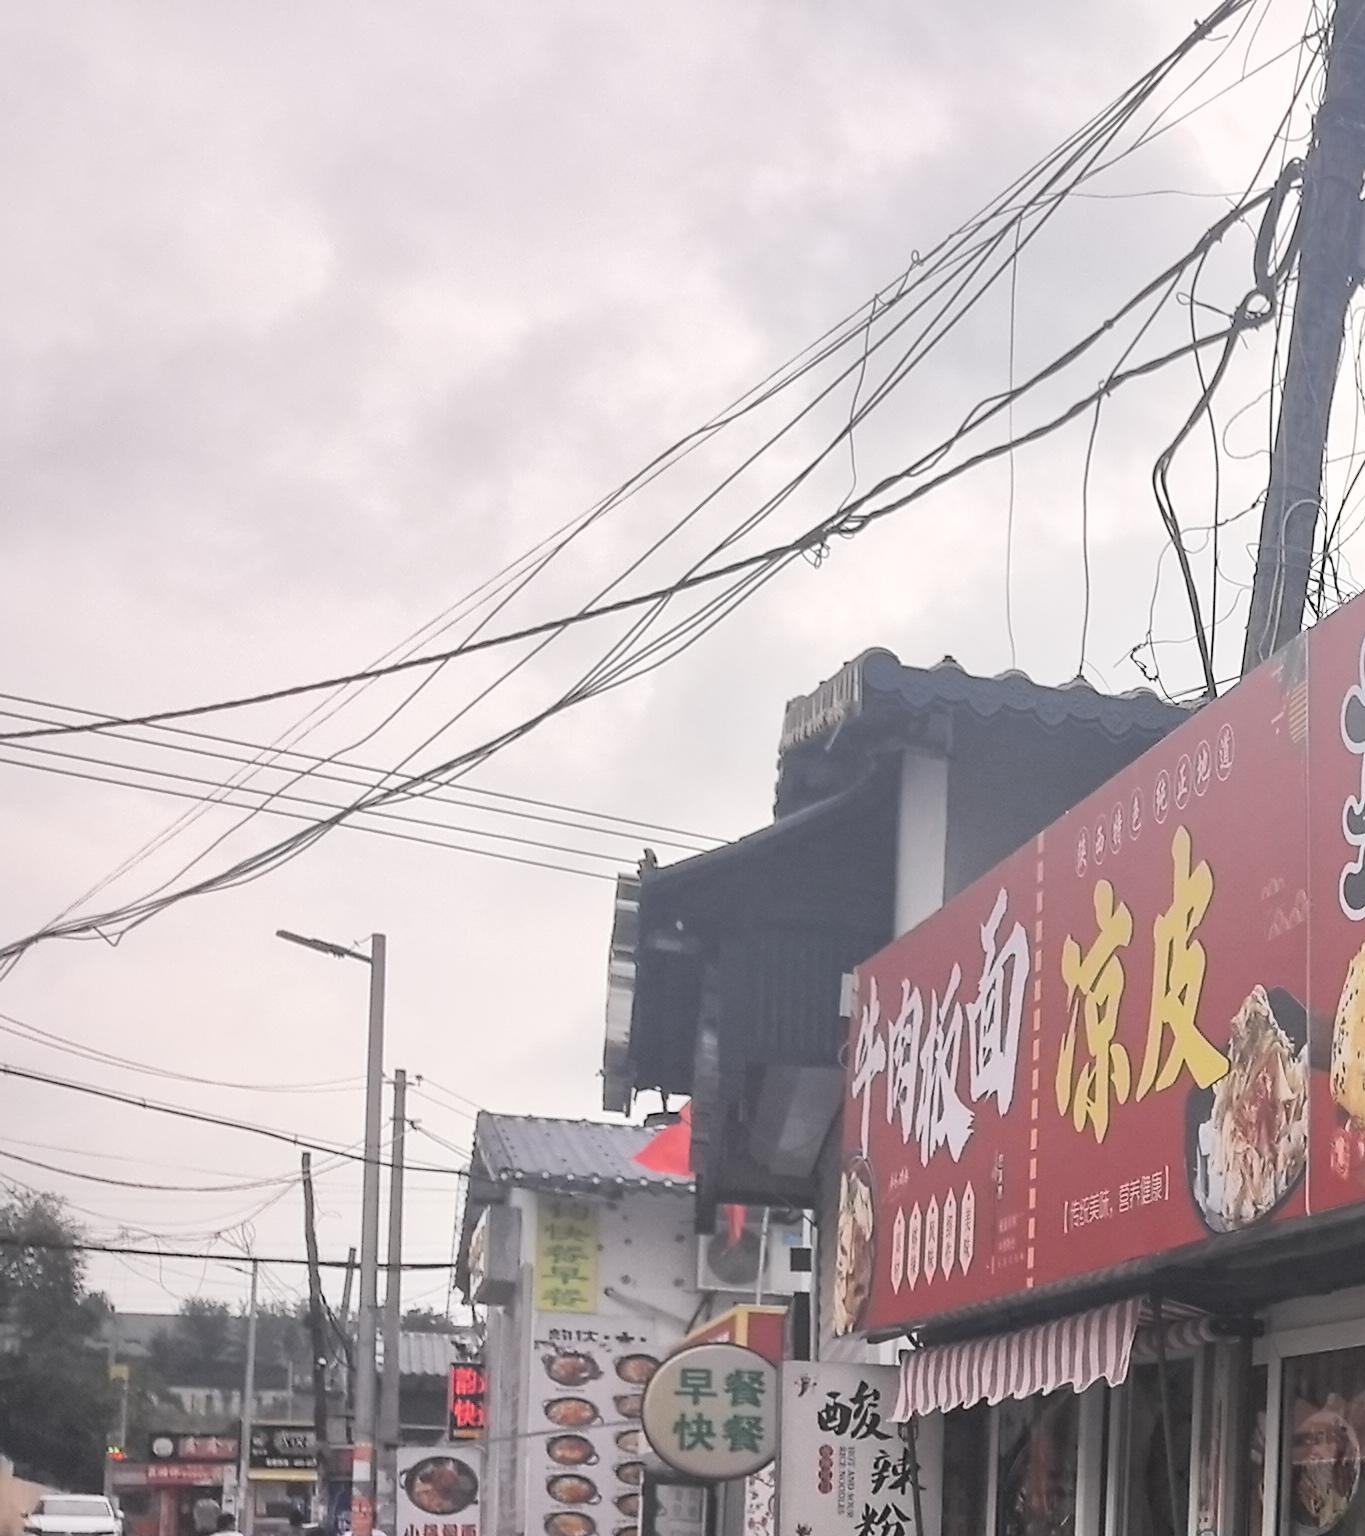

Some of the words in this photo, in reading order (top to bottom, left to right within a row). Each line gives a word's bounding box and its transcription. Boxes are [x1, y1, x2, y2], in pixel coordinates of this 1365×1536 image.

[852, 888, 1030, 1167] 牛肉板面
[1055, 825, 1231, 1143] 凉皮
[675, 1368, 766, 1409] 早餐
[675, 1413, 765, 1454] 快餐
